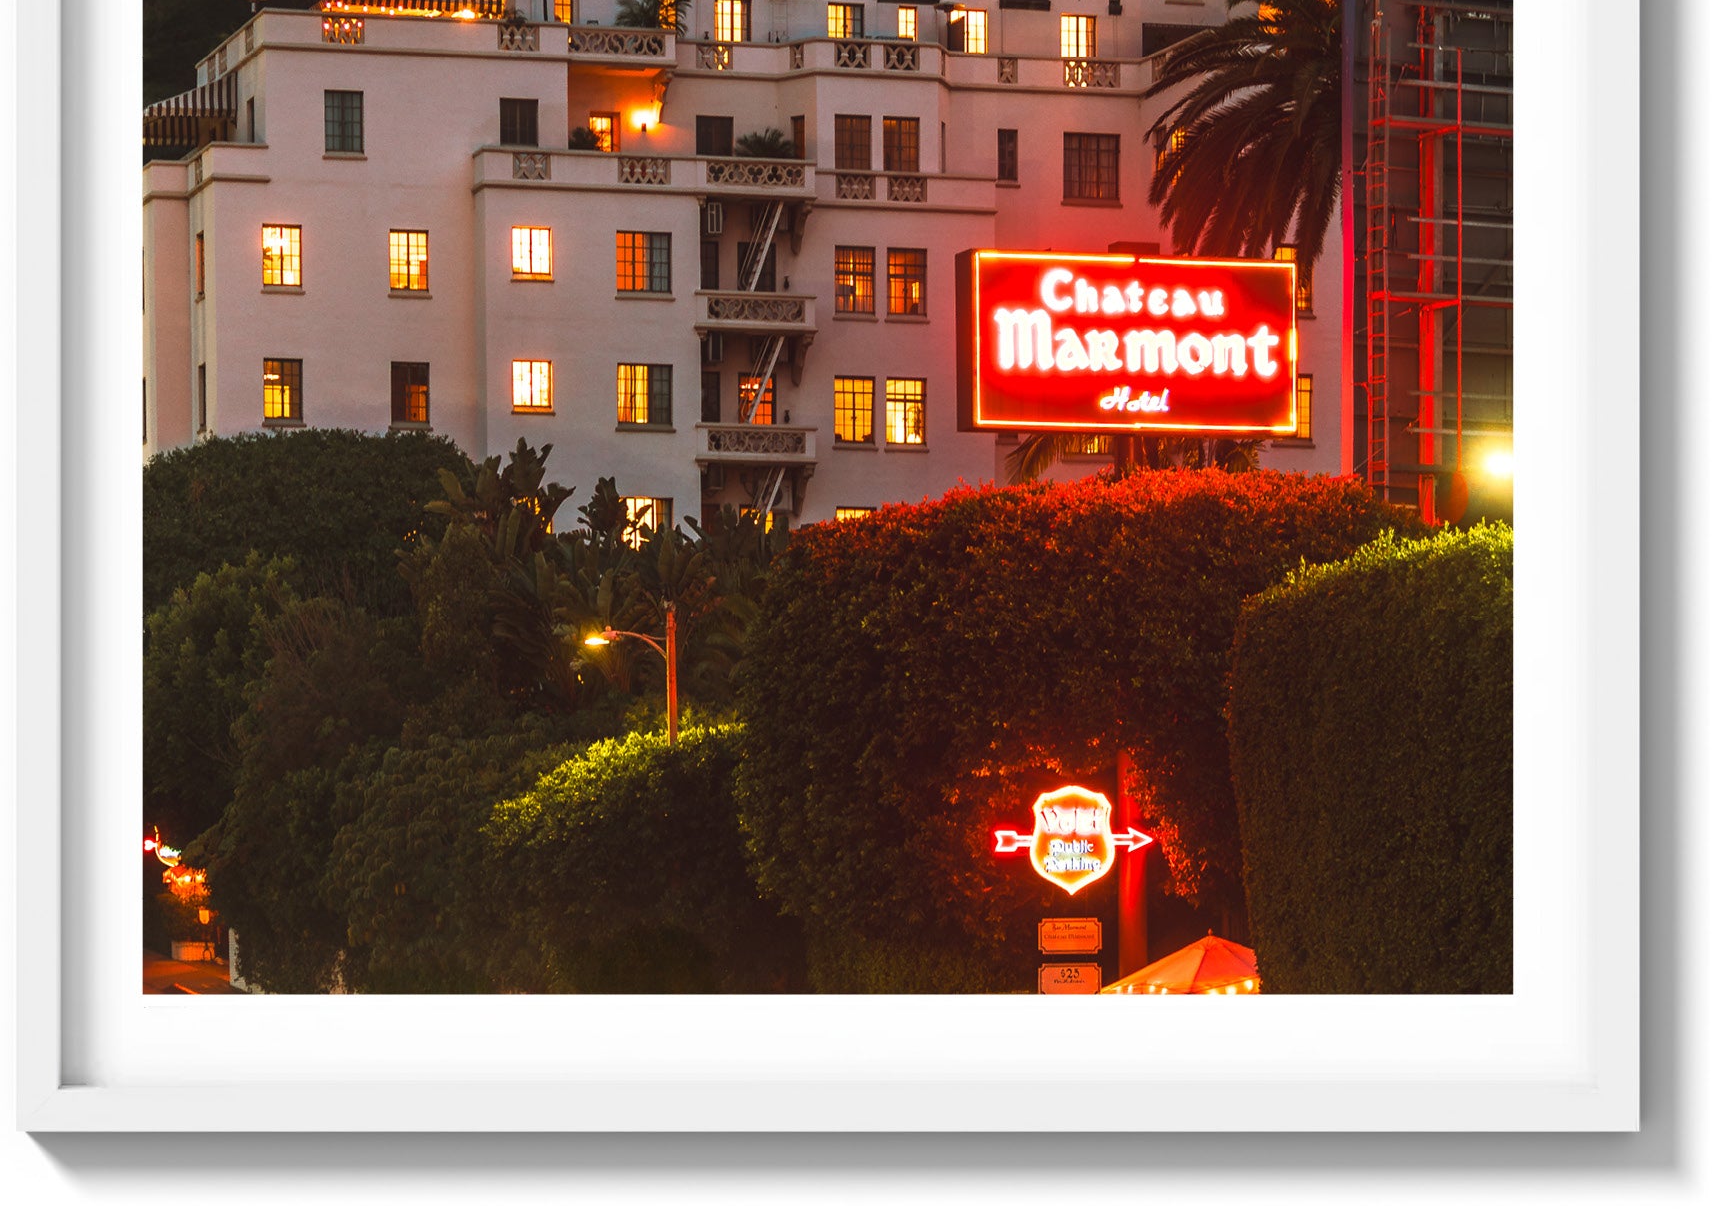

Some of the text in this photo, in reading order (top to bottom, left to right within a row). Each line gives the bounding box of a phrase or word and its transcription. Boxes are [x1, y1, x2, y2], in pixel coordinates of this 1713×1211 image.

[1040, 266, 1225, 318] Chateau
[993, 307, 1279, 377] Marmont
[1099, 386, 1170, 412] Hotel
[1049, 839, 1094, 857] Public
[1060, 968, 1080, 979] $25
